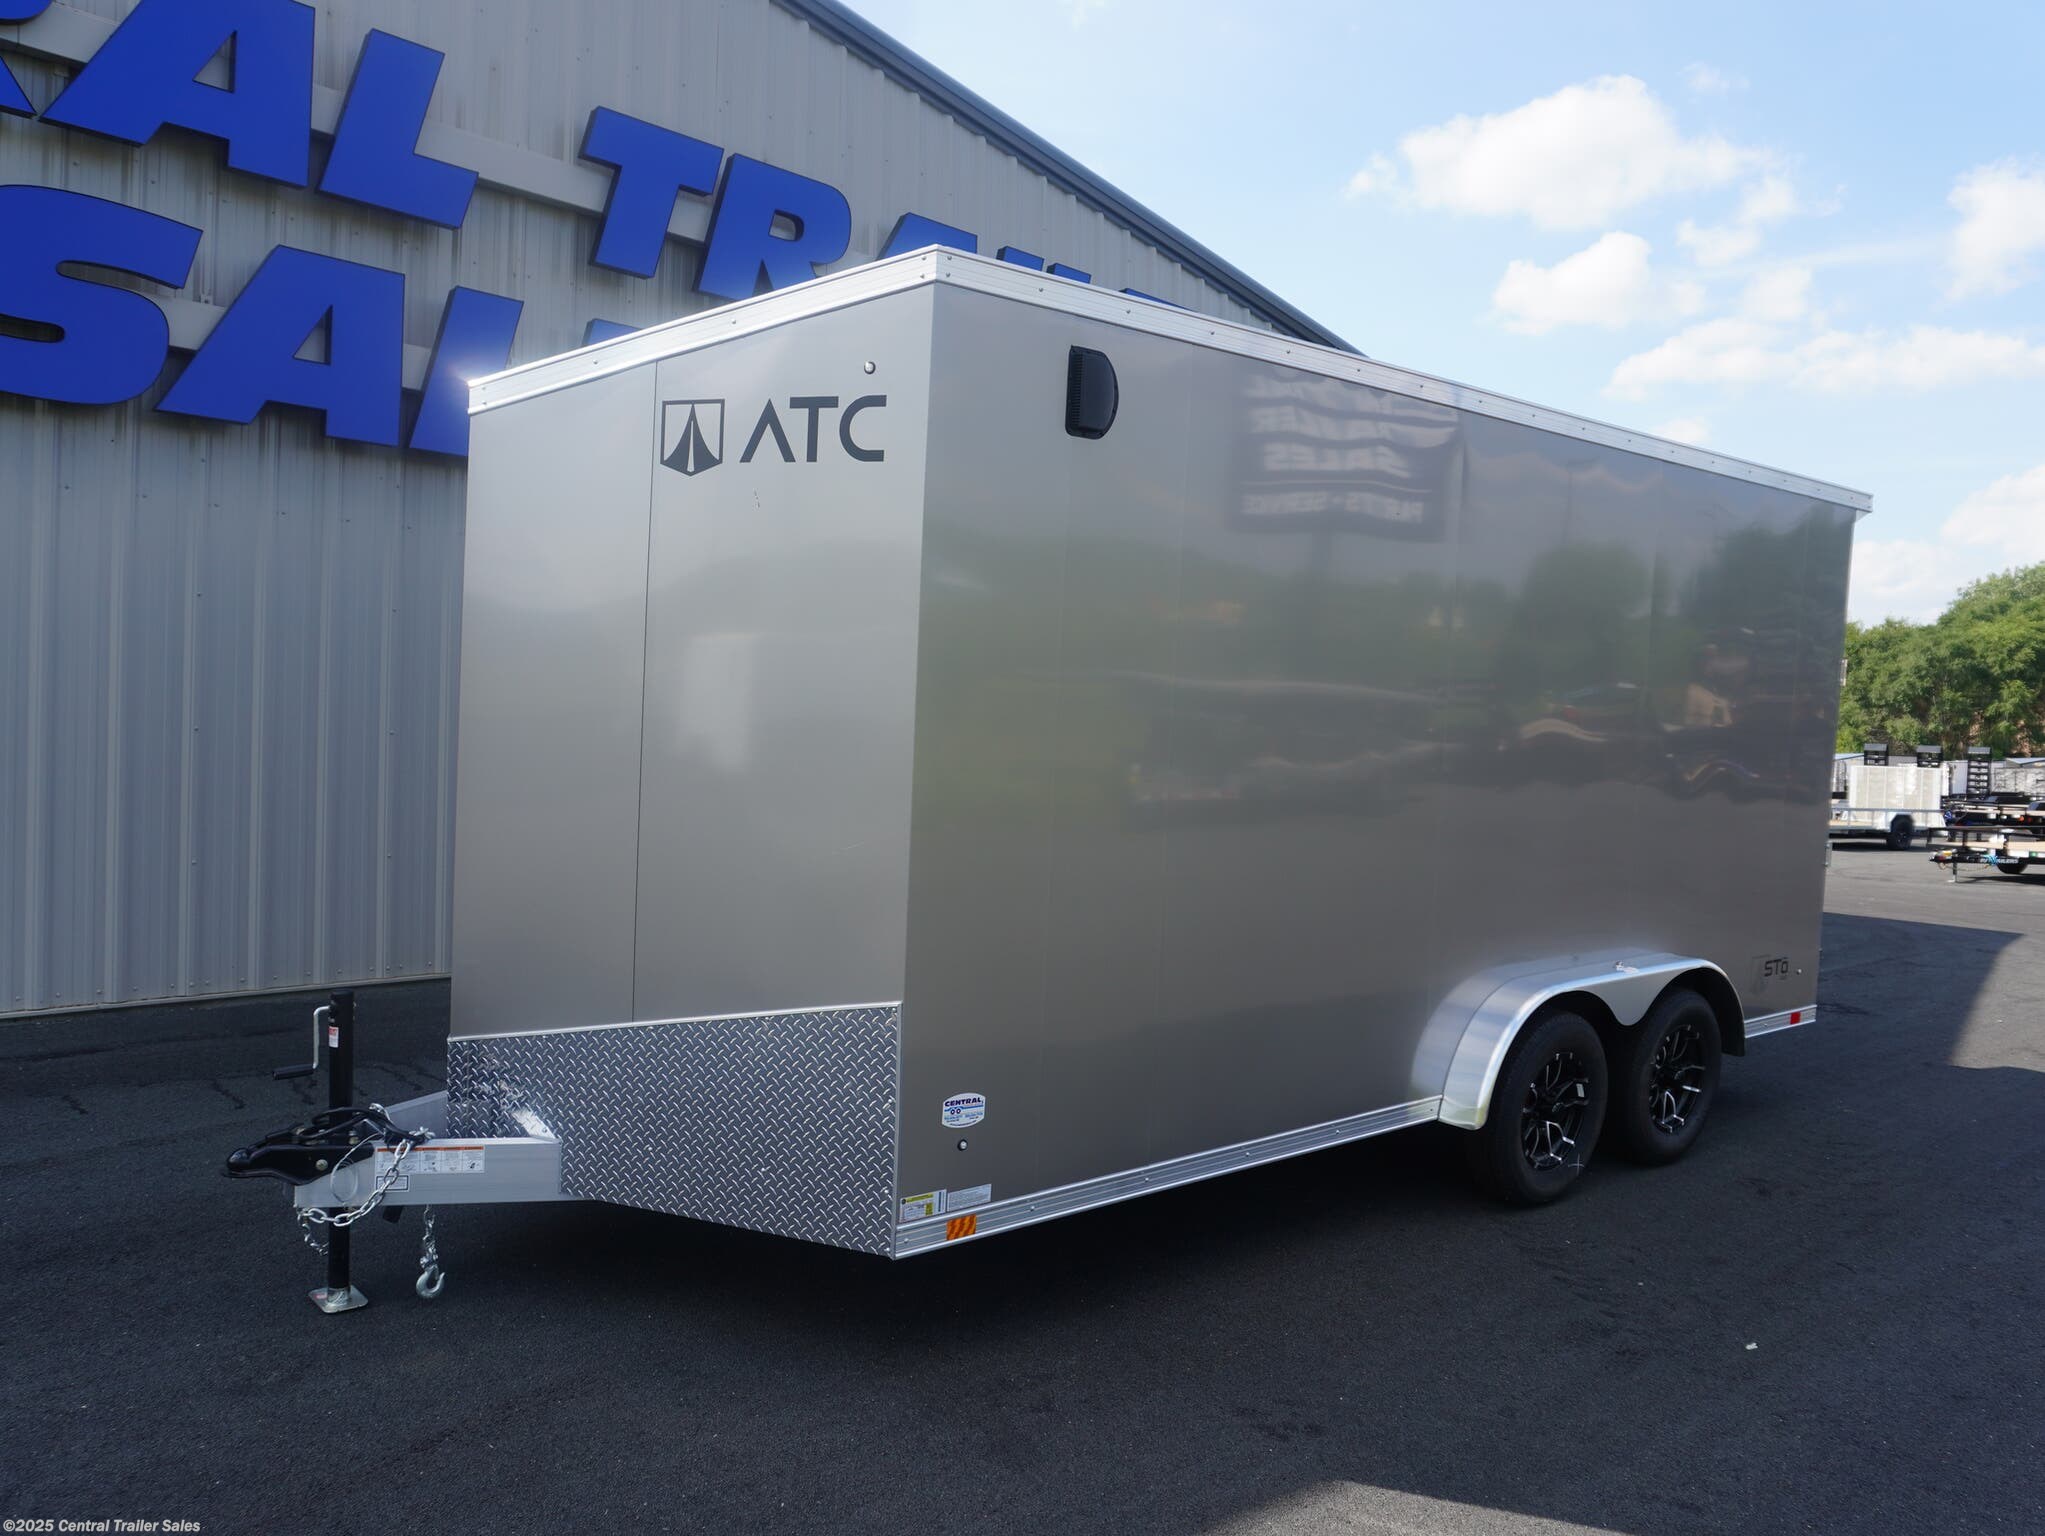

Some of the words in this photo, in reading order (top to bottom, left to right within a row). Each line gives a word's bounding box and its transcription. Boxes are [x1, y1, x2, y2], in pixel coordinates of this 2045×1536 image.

[0, 0, 478, 229] AL
[739, 394, 888, 463] ATC
[944, 1097, 982, 1107] CENTRAL
